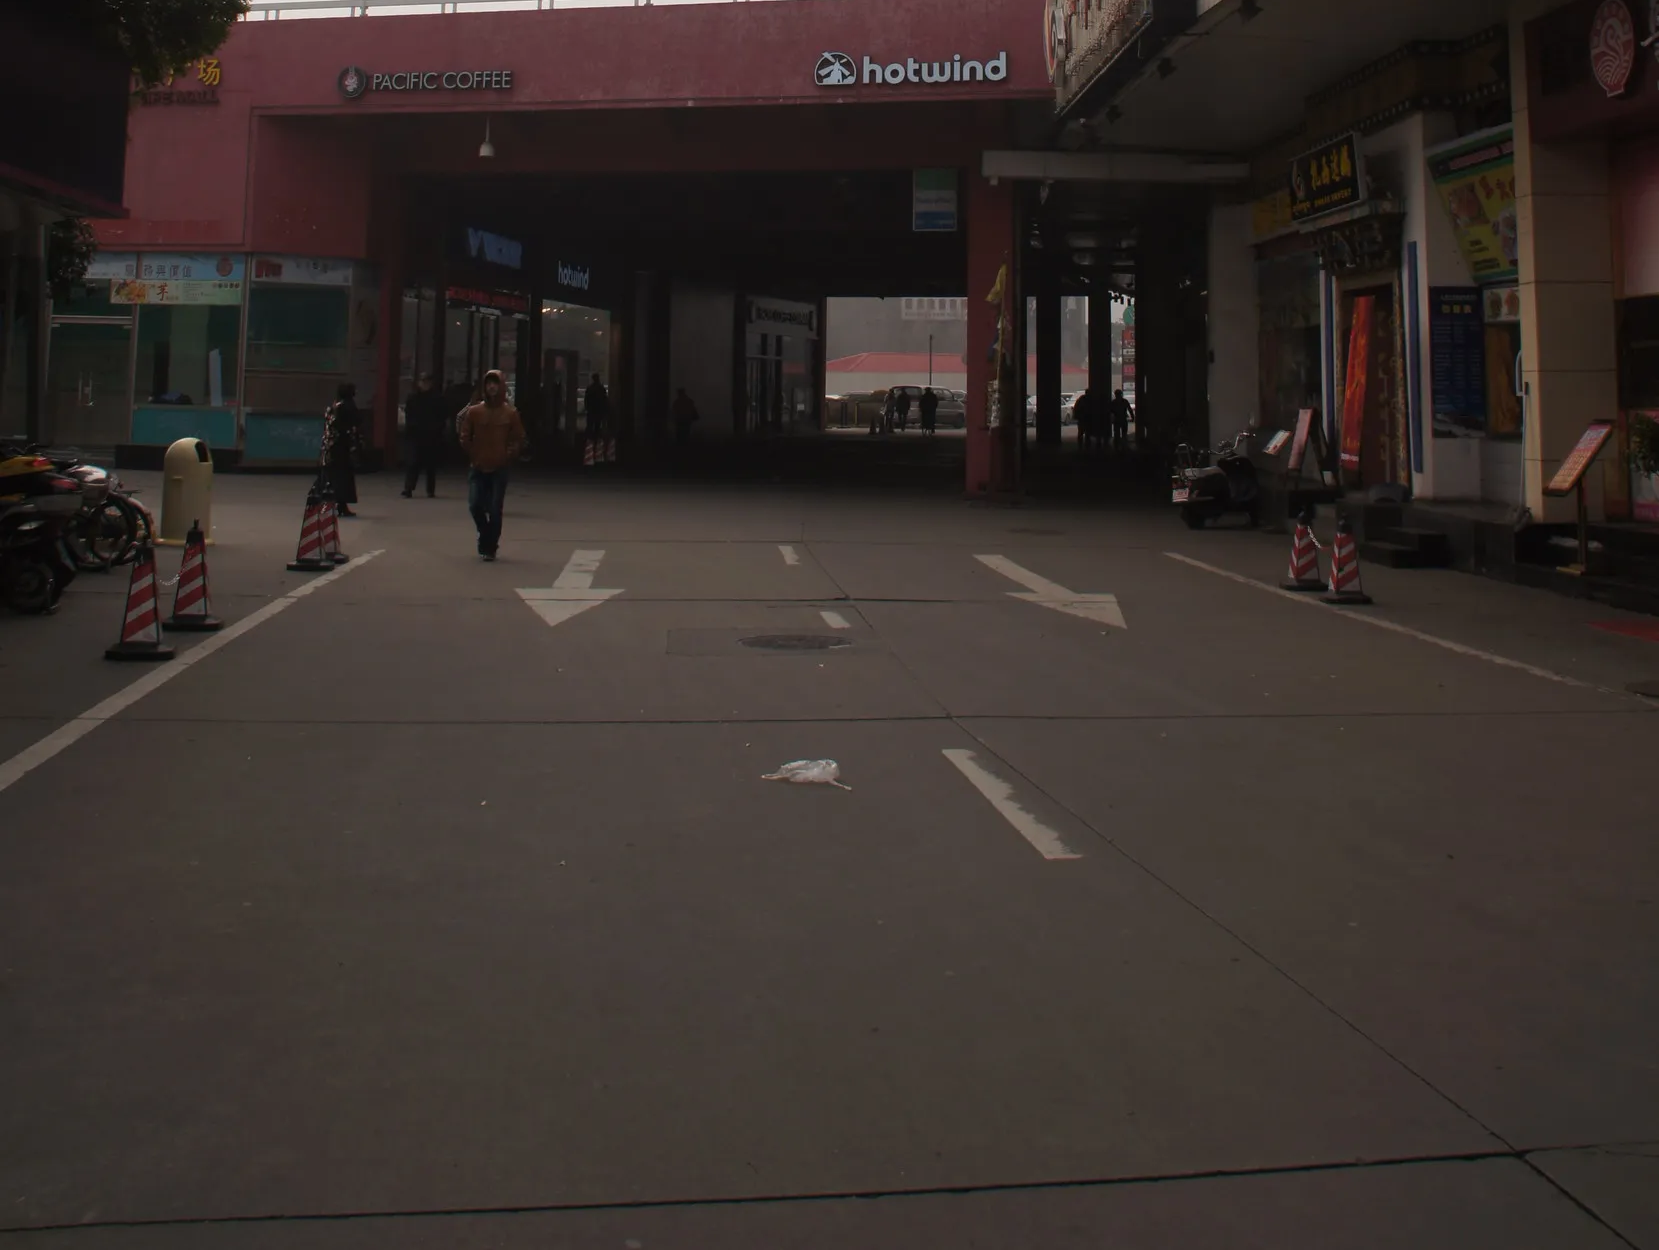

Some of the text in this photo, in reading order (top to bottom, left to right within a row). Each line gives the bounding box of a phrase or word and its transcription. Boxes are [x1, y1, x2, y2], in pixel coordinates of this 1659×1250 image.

[372, 70, 512, 90] PACIFIC COFFEE
[861, 51, 1007, 85] hotwind
[557, 260, 590, 291] hotwind
